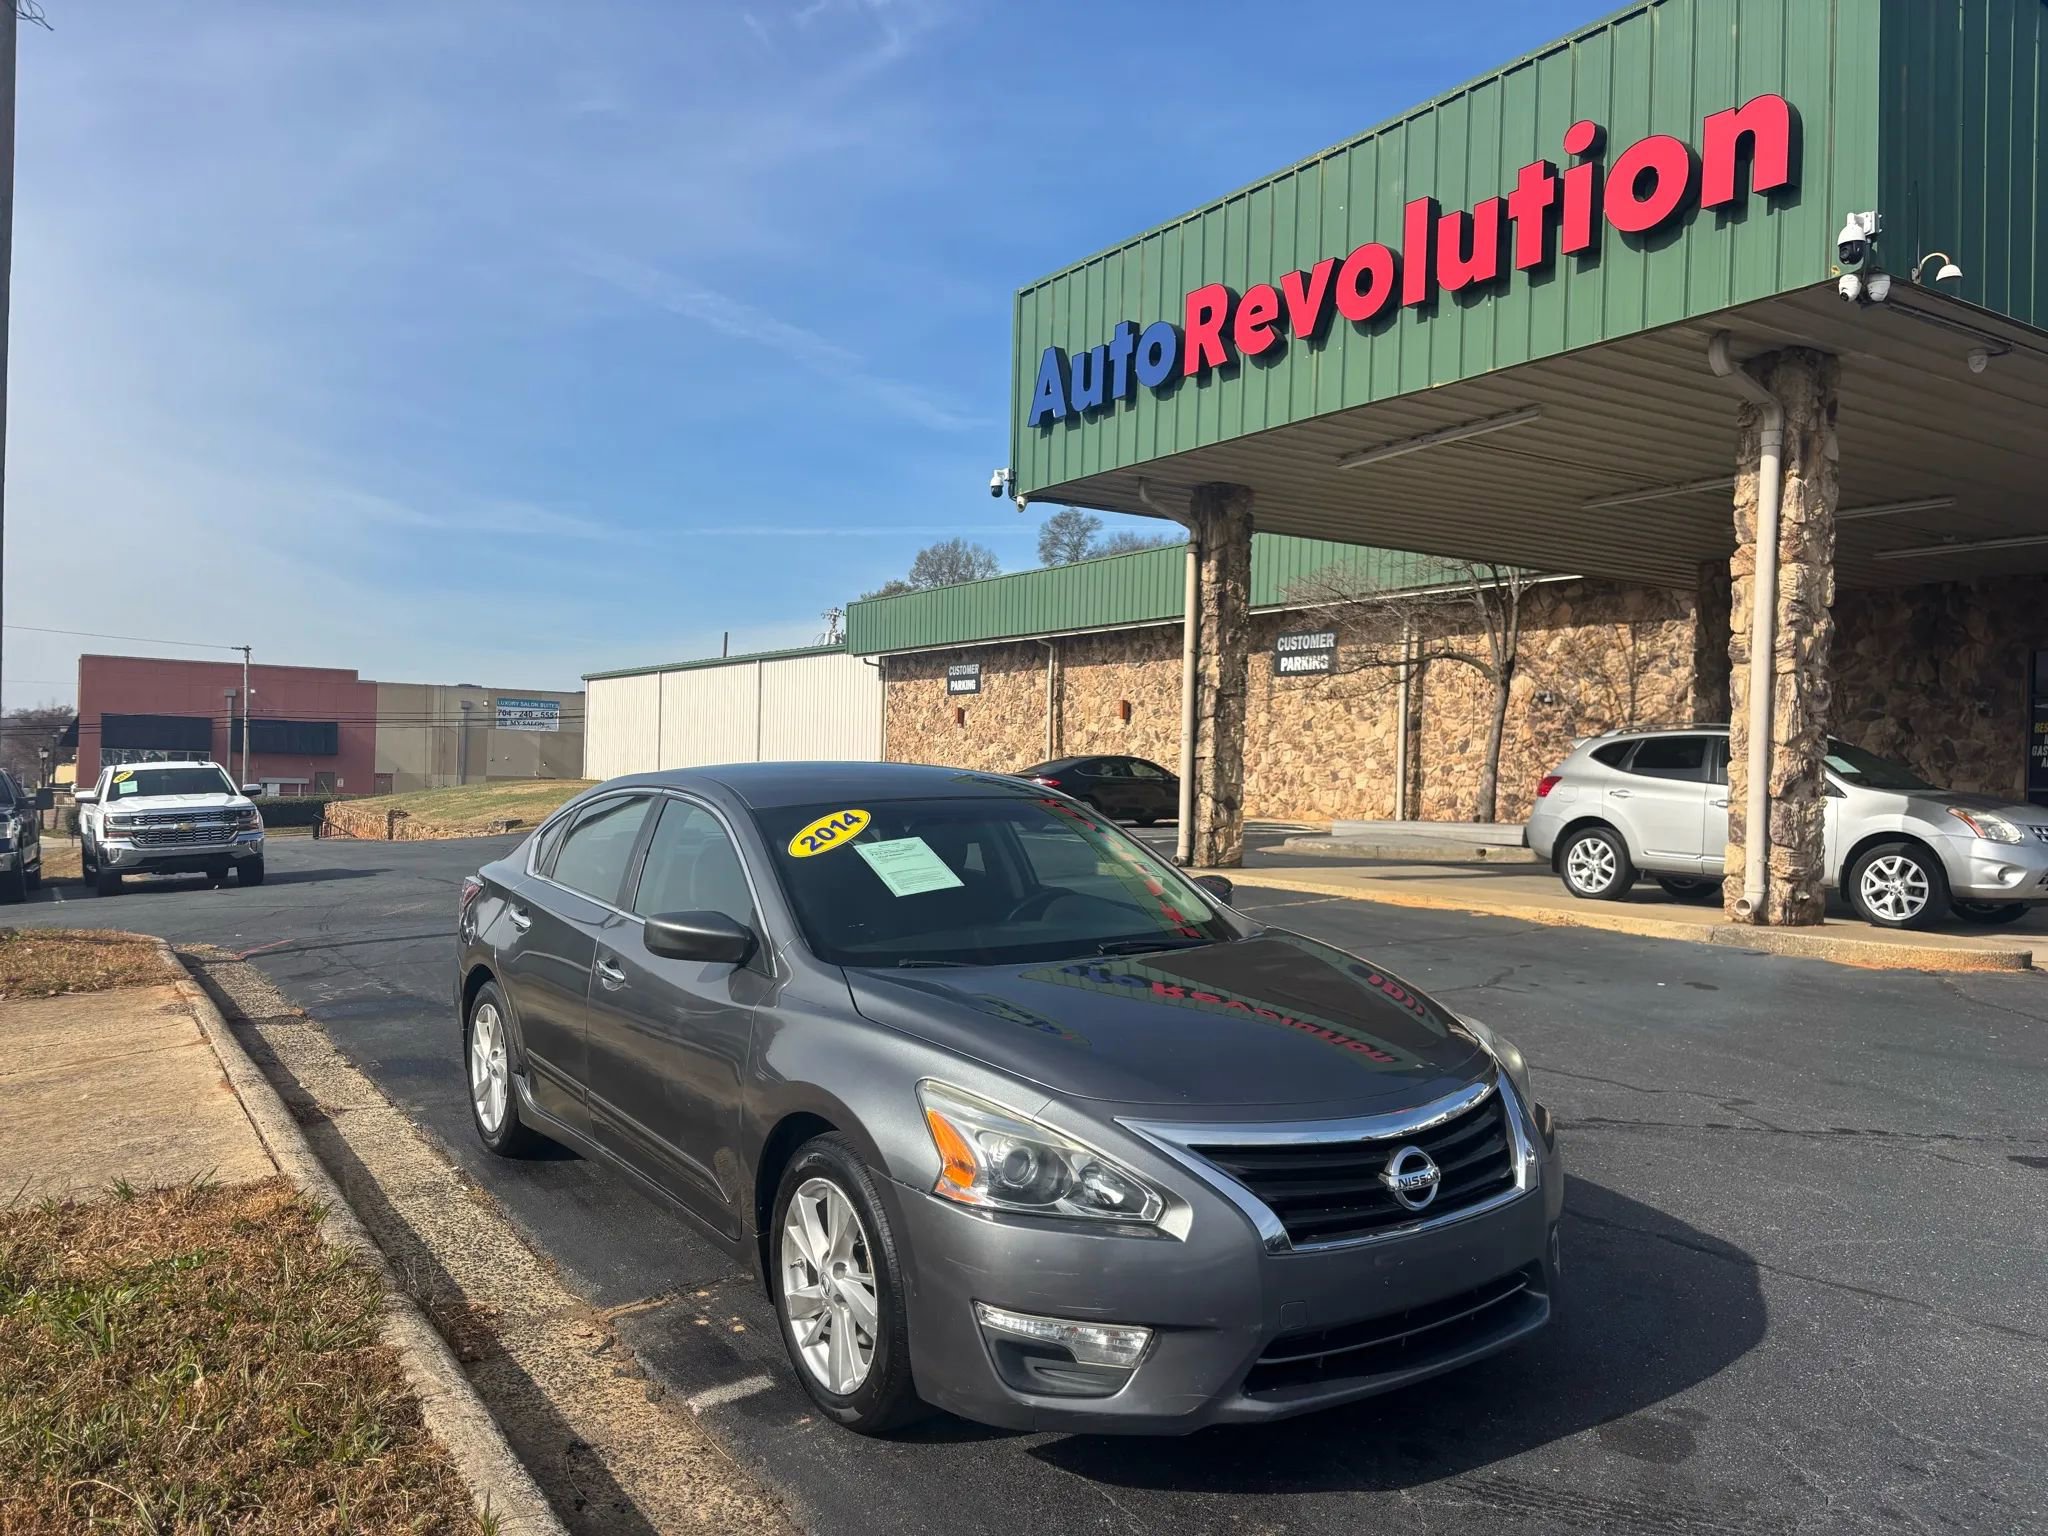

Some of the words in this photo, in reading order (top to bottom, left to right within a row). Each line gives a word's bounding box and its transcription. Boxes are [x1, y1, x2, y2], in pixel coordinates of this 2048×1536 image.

[1277, 633, 1335, 651] CUSTOMER
[948, 664, 980, 676] CUSTOMER
[1280, 655, 1329, 671] PARKING
[950, 680, 976, 691] PARKING
[800, 813, 862, 852] 2014
[1398, 1168, 1440, 1188] NISSAN
